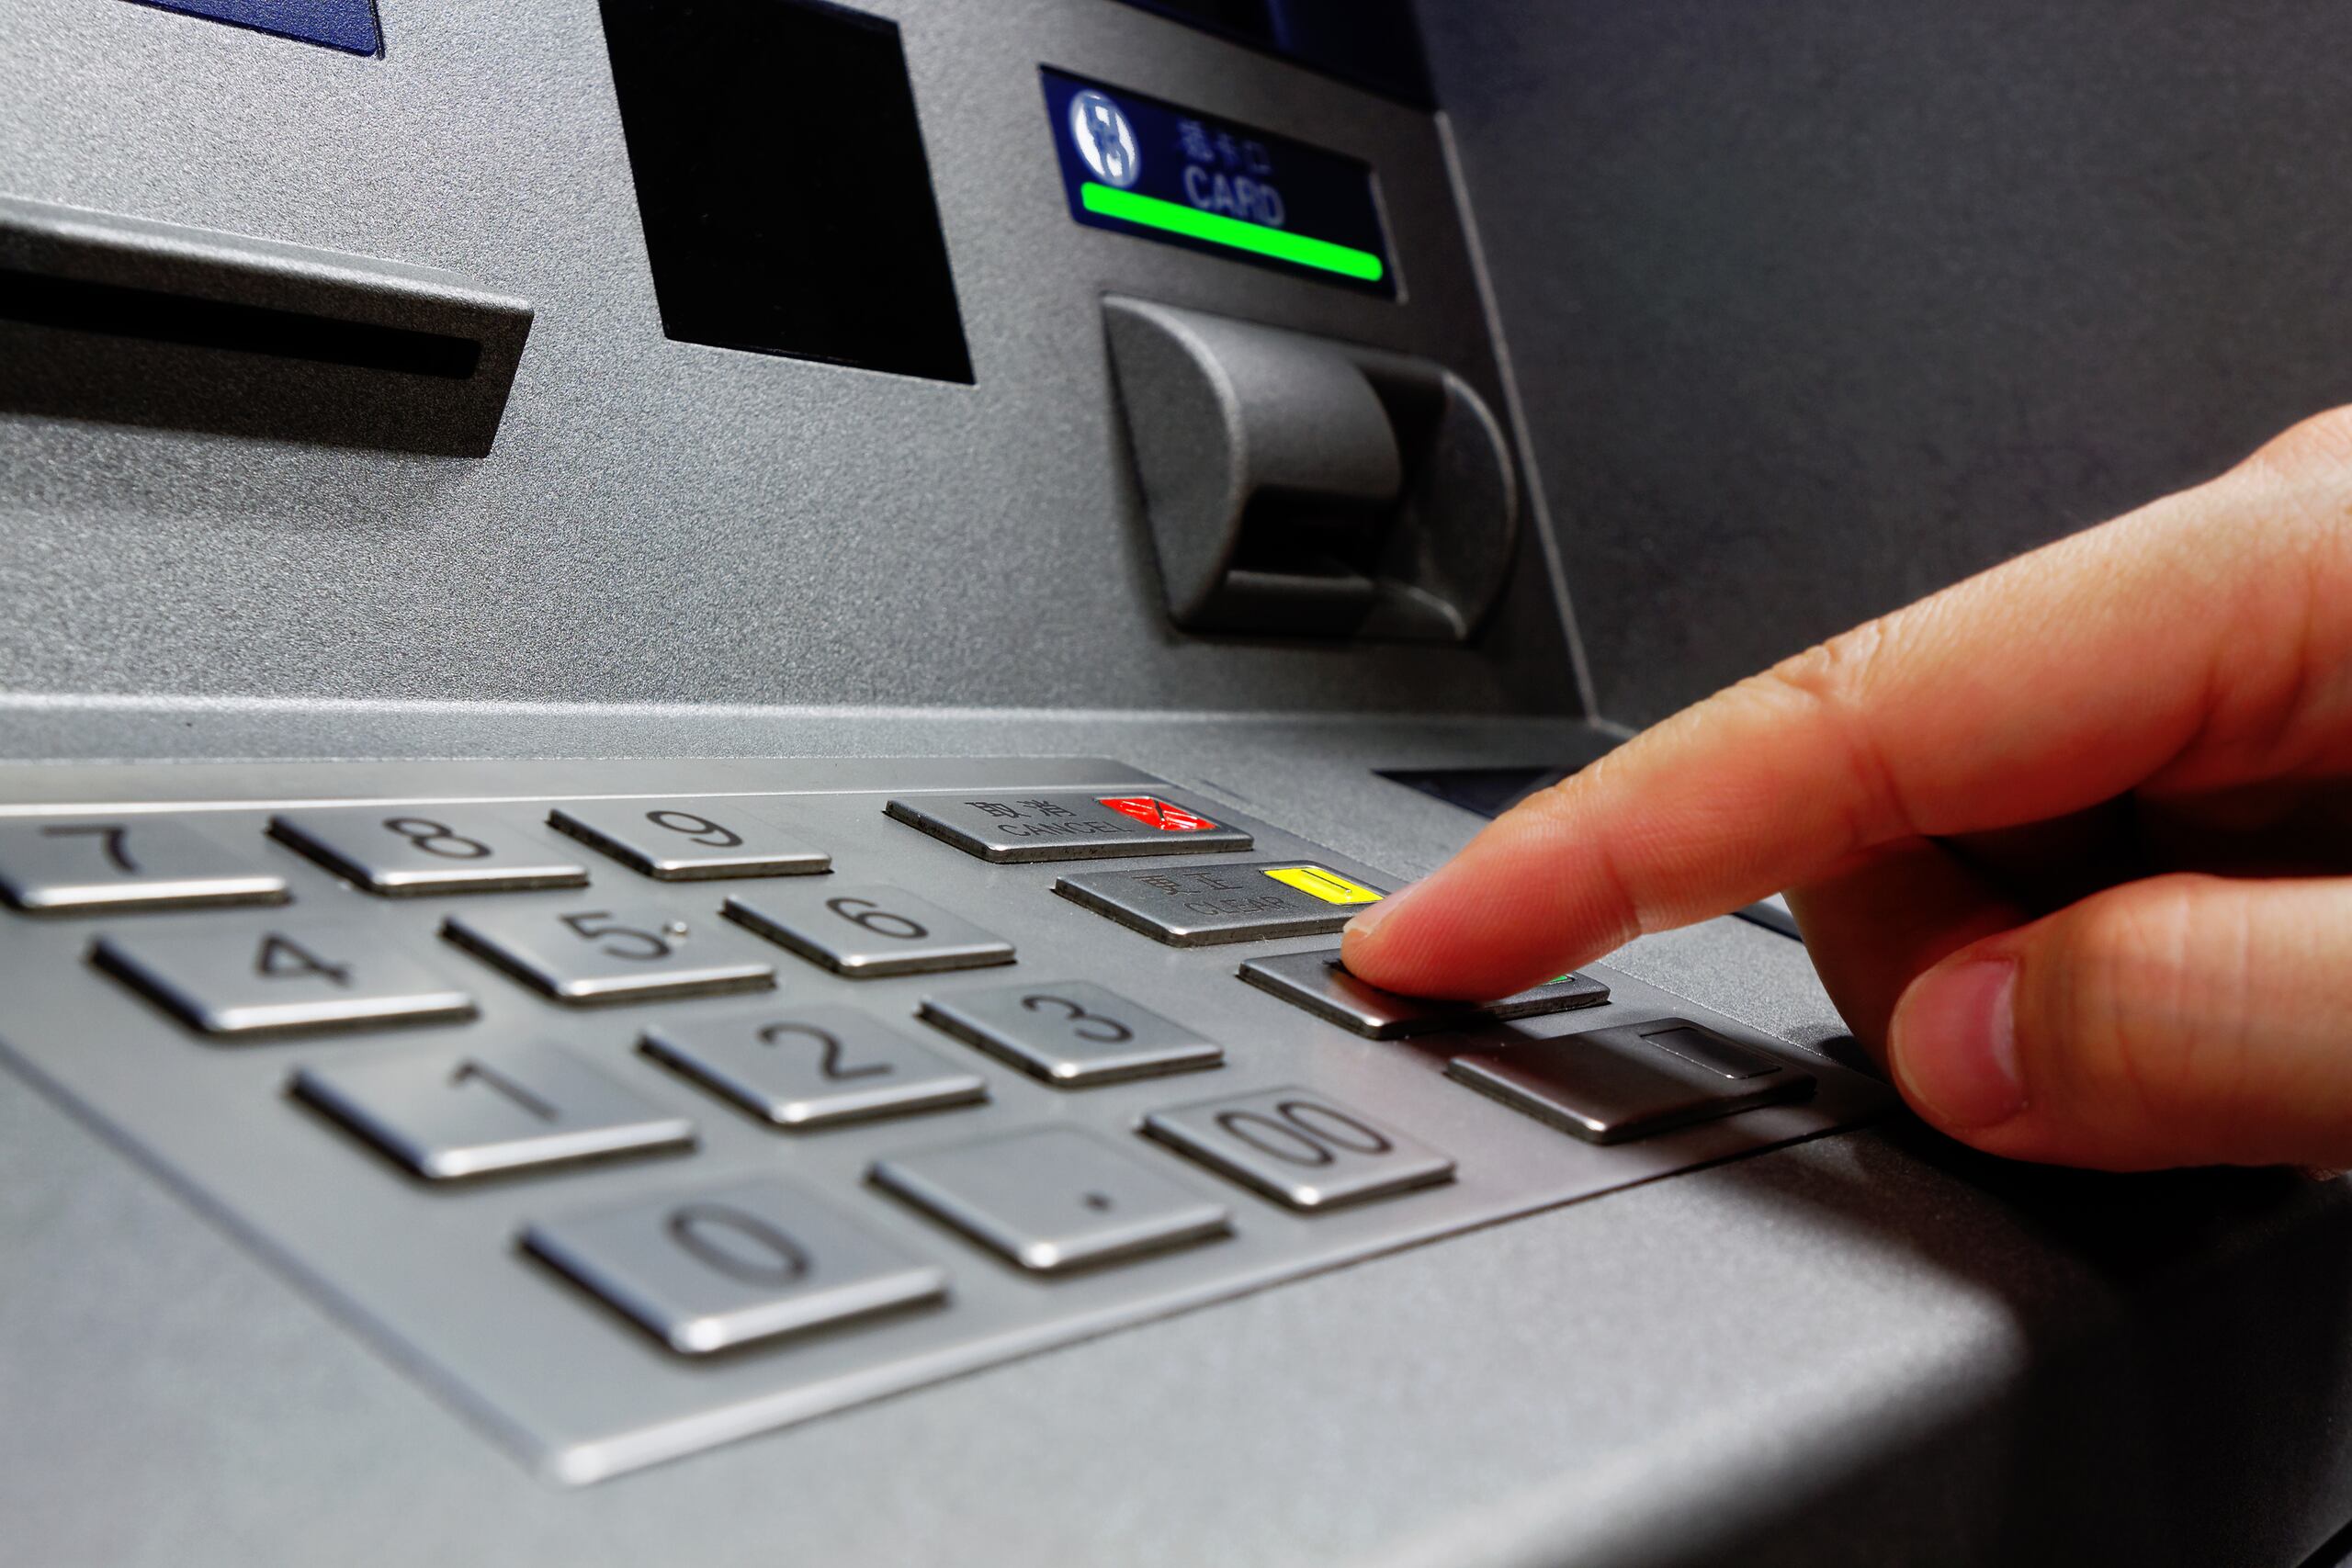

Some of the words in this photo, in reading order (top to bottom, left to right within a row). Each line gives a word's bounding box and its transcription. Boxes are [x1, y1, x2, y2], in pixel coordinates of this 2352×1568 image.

[1183, 164, 1285, 227] CARD
[645, 809, 744, 848] 9
[965, 799, 1077, 818] 取消
[998, 821, 1136, 837] CANCEL
[40, 823, 141, 874] 7
[382, 816, 493, 859] 8
[826, 897, 929, 940] 6
[1183, 897, 1301, 916] CLEAR
[254, 932, 352, 986] 4
[559, 910, 673, 961] 5
[1021, 994, 1135, 1044] 3
[756, 1021, 896, 1081] 2
[449, 1058, 561, 1123] 1
[1214, 1100, 1395, 1168] 00
[663, 1201, 818, 1290] 0
